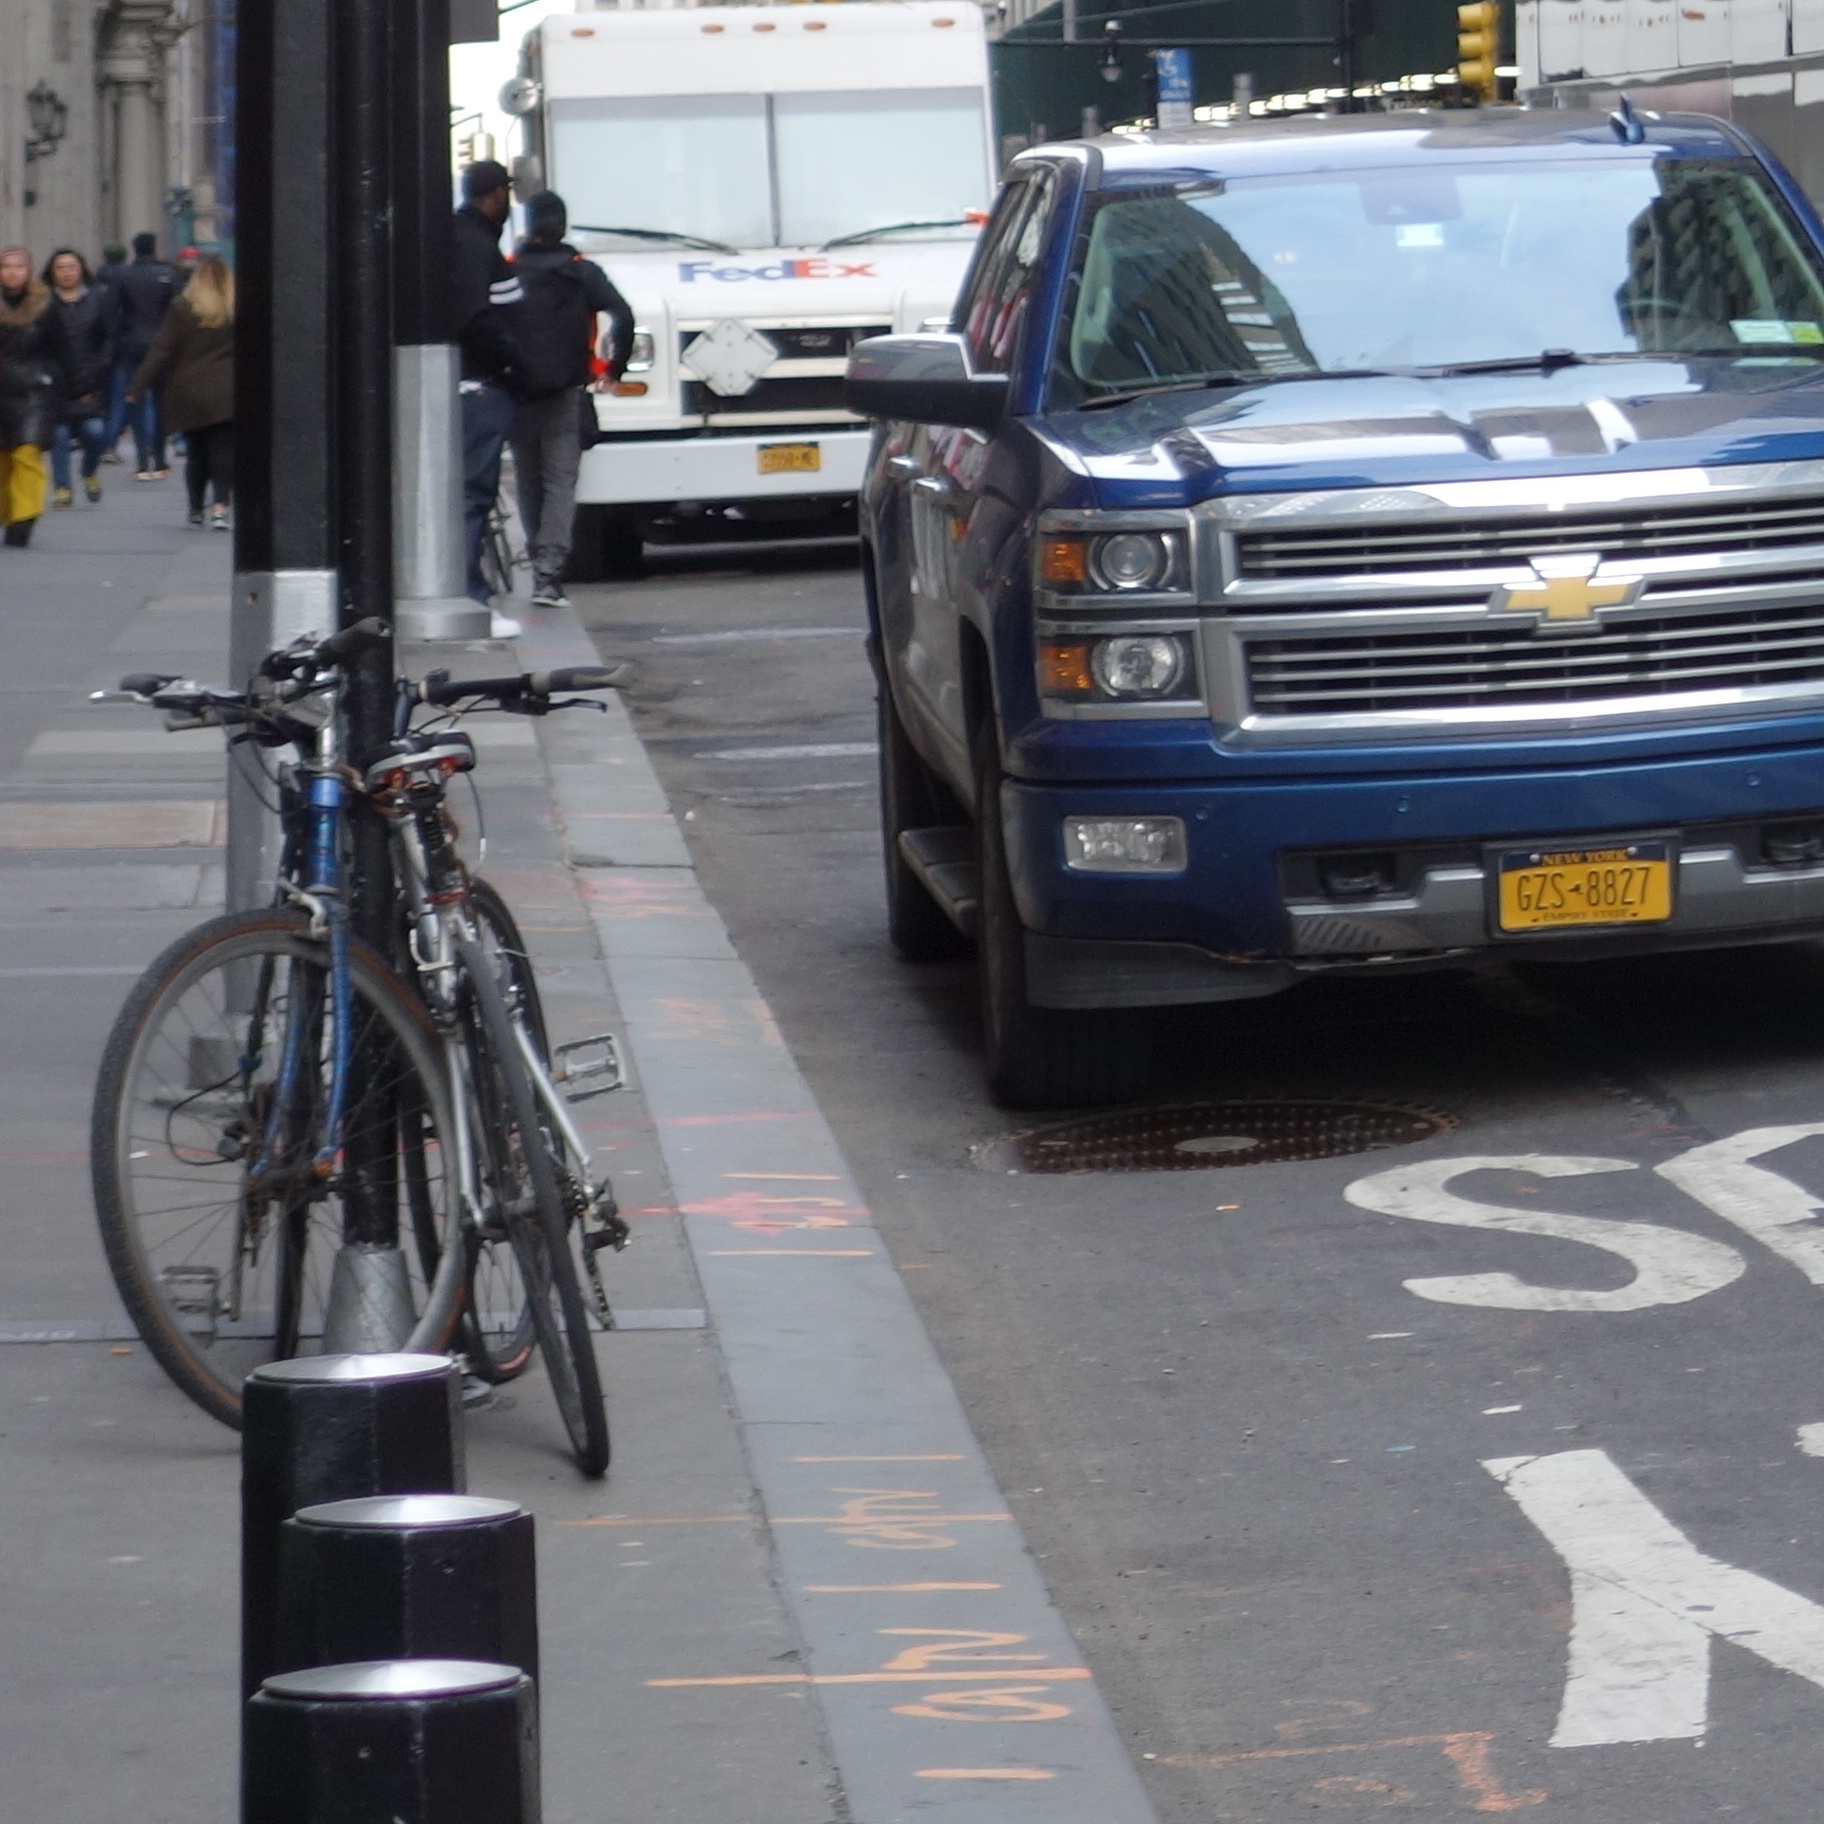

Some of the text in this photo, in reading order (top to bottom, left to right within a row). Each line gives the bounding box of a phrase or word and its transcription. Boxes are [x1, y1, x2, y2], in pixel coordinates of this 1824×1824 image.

[678, 254, 880, 283] FedEx
[1542, 849, 1628, 866] NEW YORK
